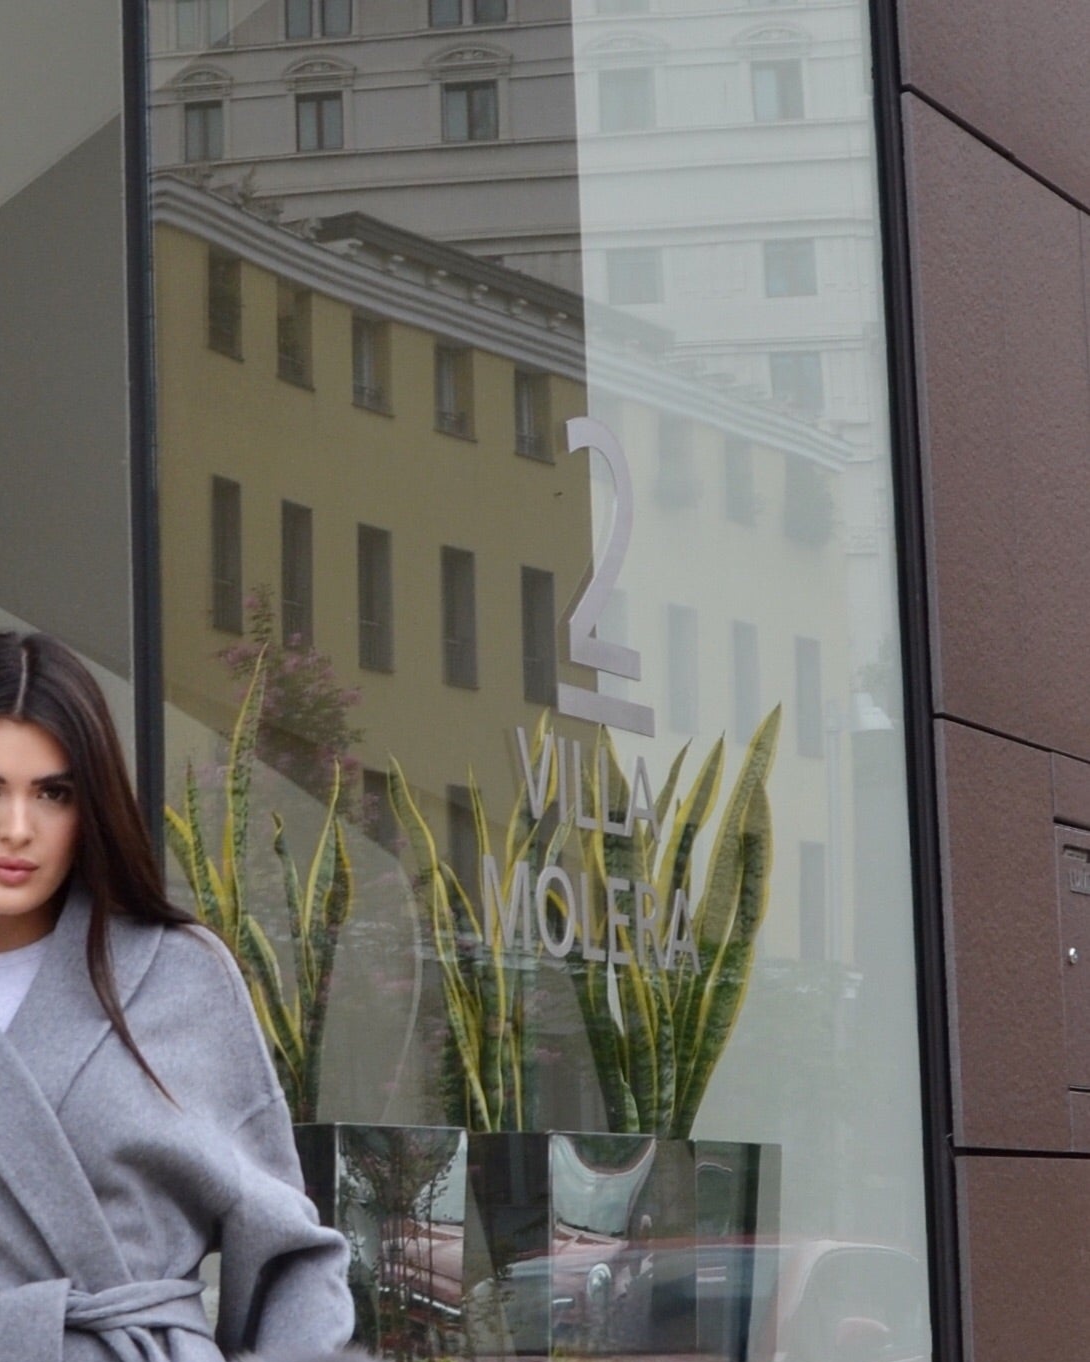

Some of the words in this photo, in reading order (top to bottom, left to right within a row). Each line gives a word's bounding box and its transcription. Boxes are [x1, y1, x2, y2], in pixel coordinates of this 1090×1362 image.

[566, 416, 641, 681] 2
[516, 726, 661, 844] VILLA
[482, 853, 701, 975] MOLERA
